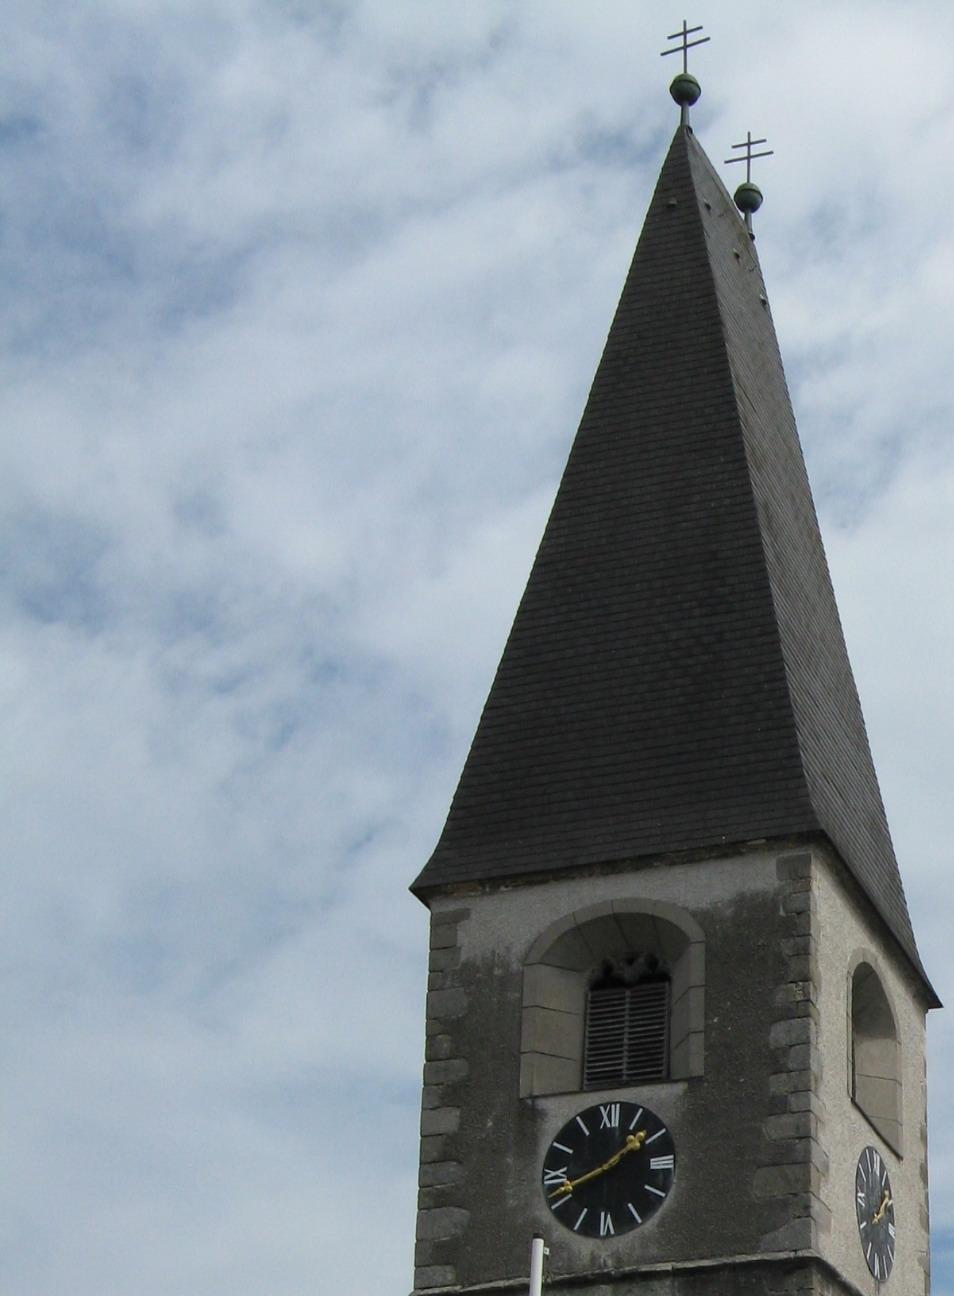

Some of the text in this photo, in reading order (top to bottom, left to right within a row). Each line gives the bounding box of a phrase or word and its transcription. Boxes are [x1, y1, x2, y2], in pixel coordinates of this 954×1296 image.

[599, 1103, 621, 1130] XII
[649, 1153, 675, 1170] III
[599, 1210, 616, 1237] VI
